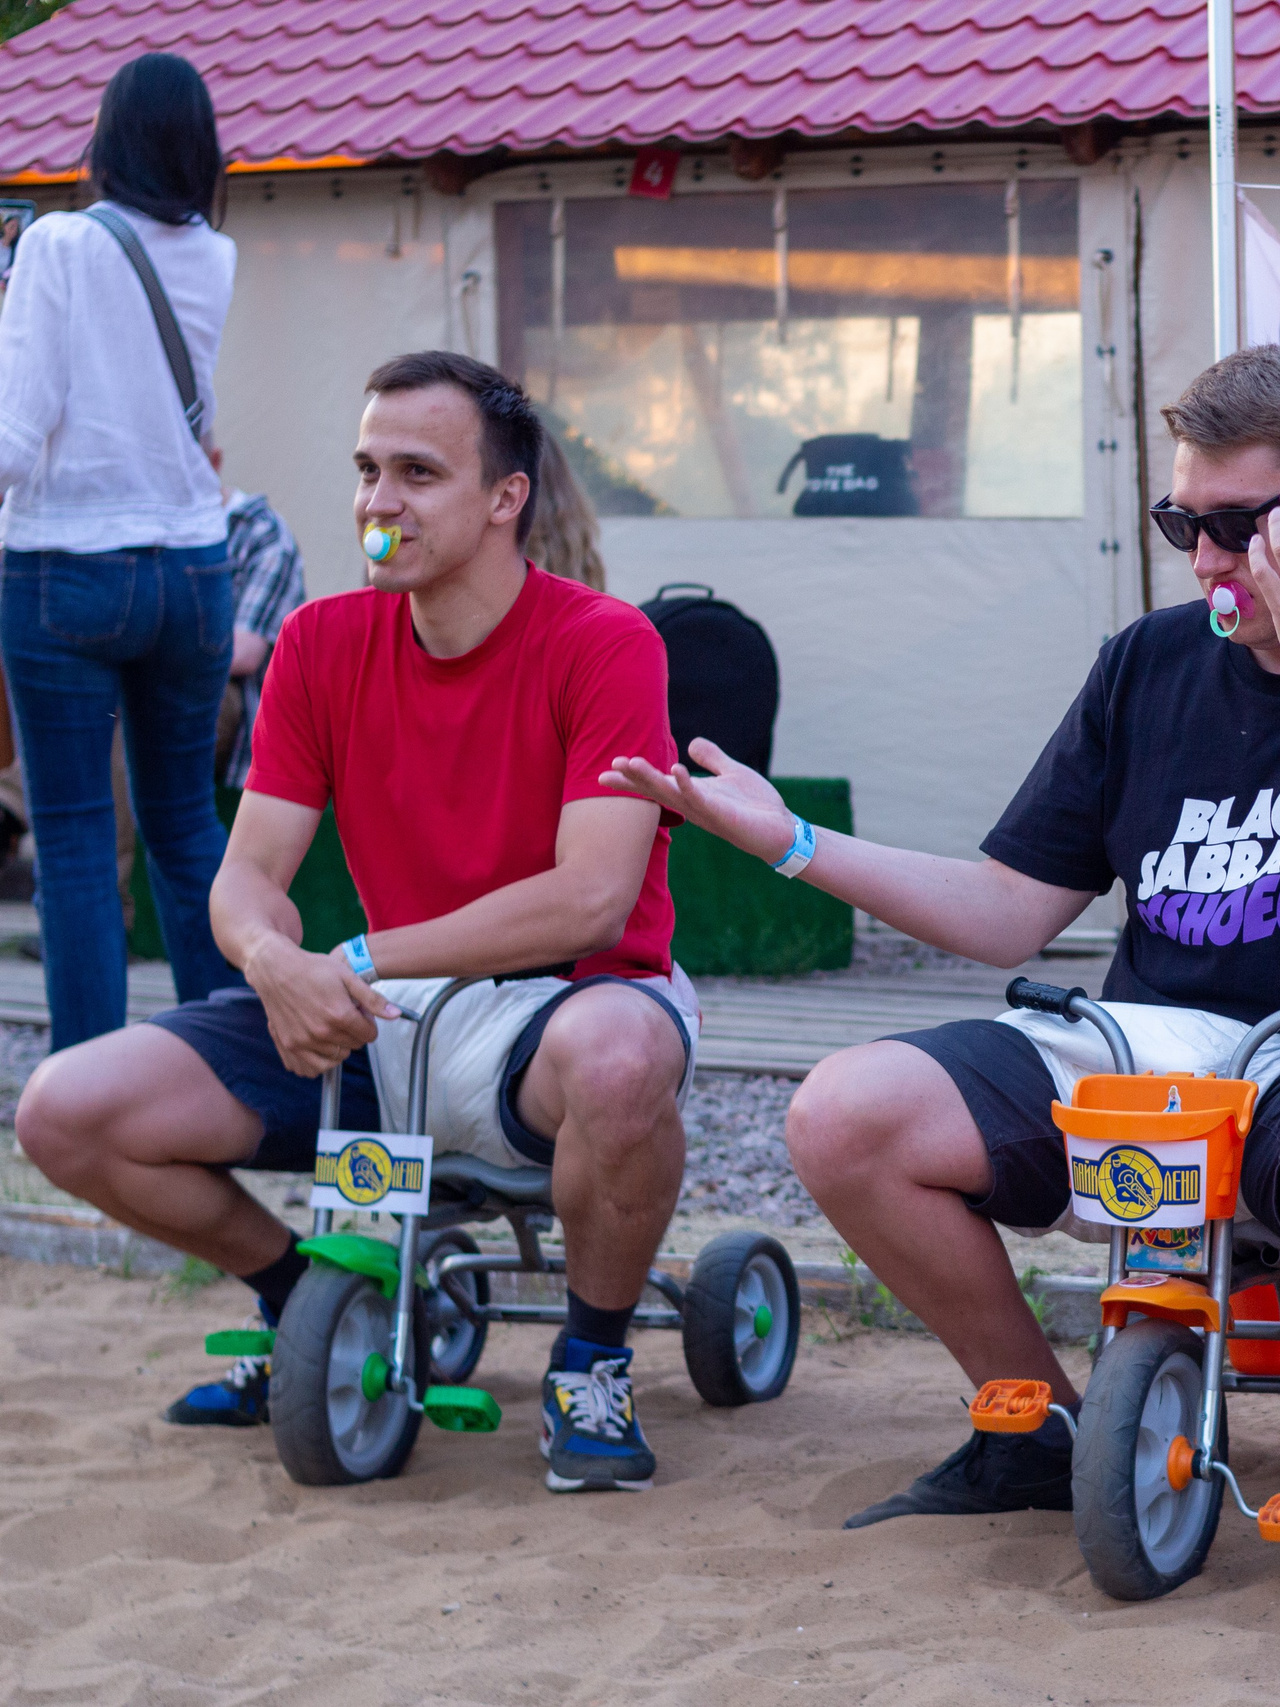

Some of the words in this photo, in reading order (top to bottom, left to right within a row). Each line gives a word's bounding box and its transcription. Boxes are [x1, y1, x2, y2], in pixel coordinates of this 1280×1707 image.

[643, 160, 664, 187] 4
[1072, 1160, 1099, 1196] БАЙК
[1163, 1169, 1199, 1201] ЛЕНД
